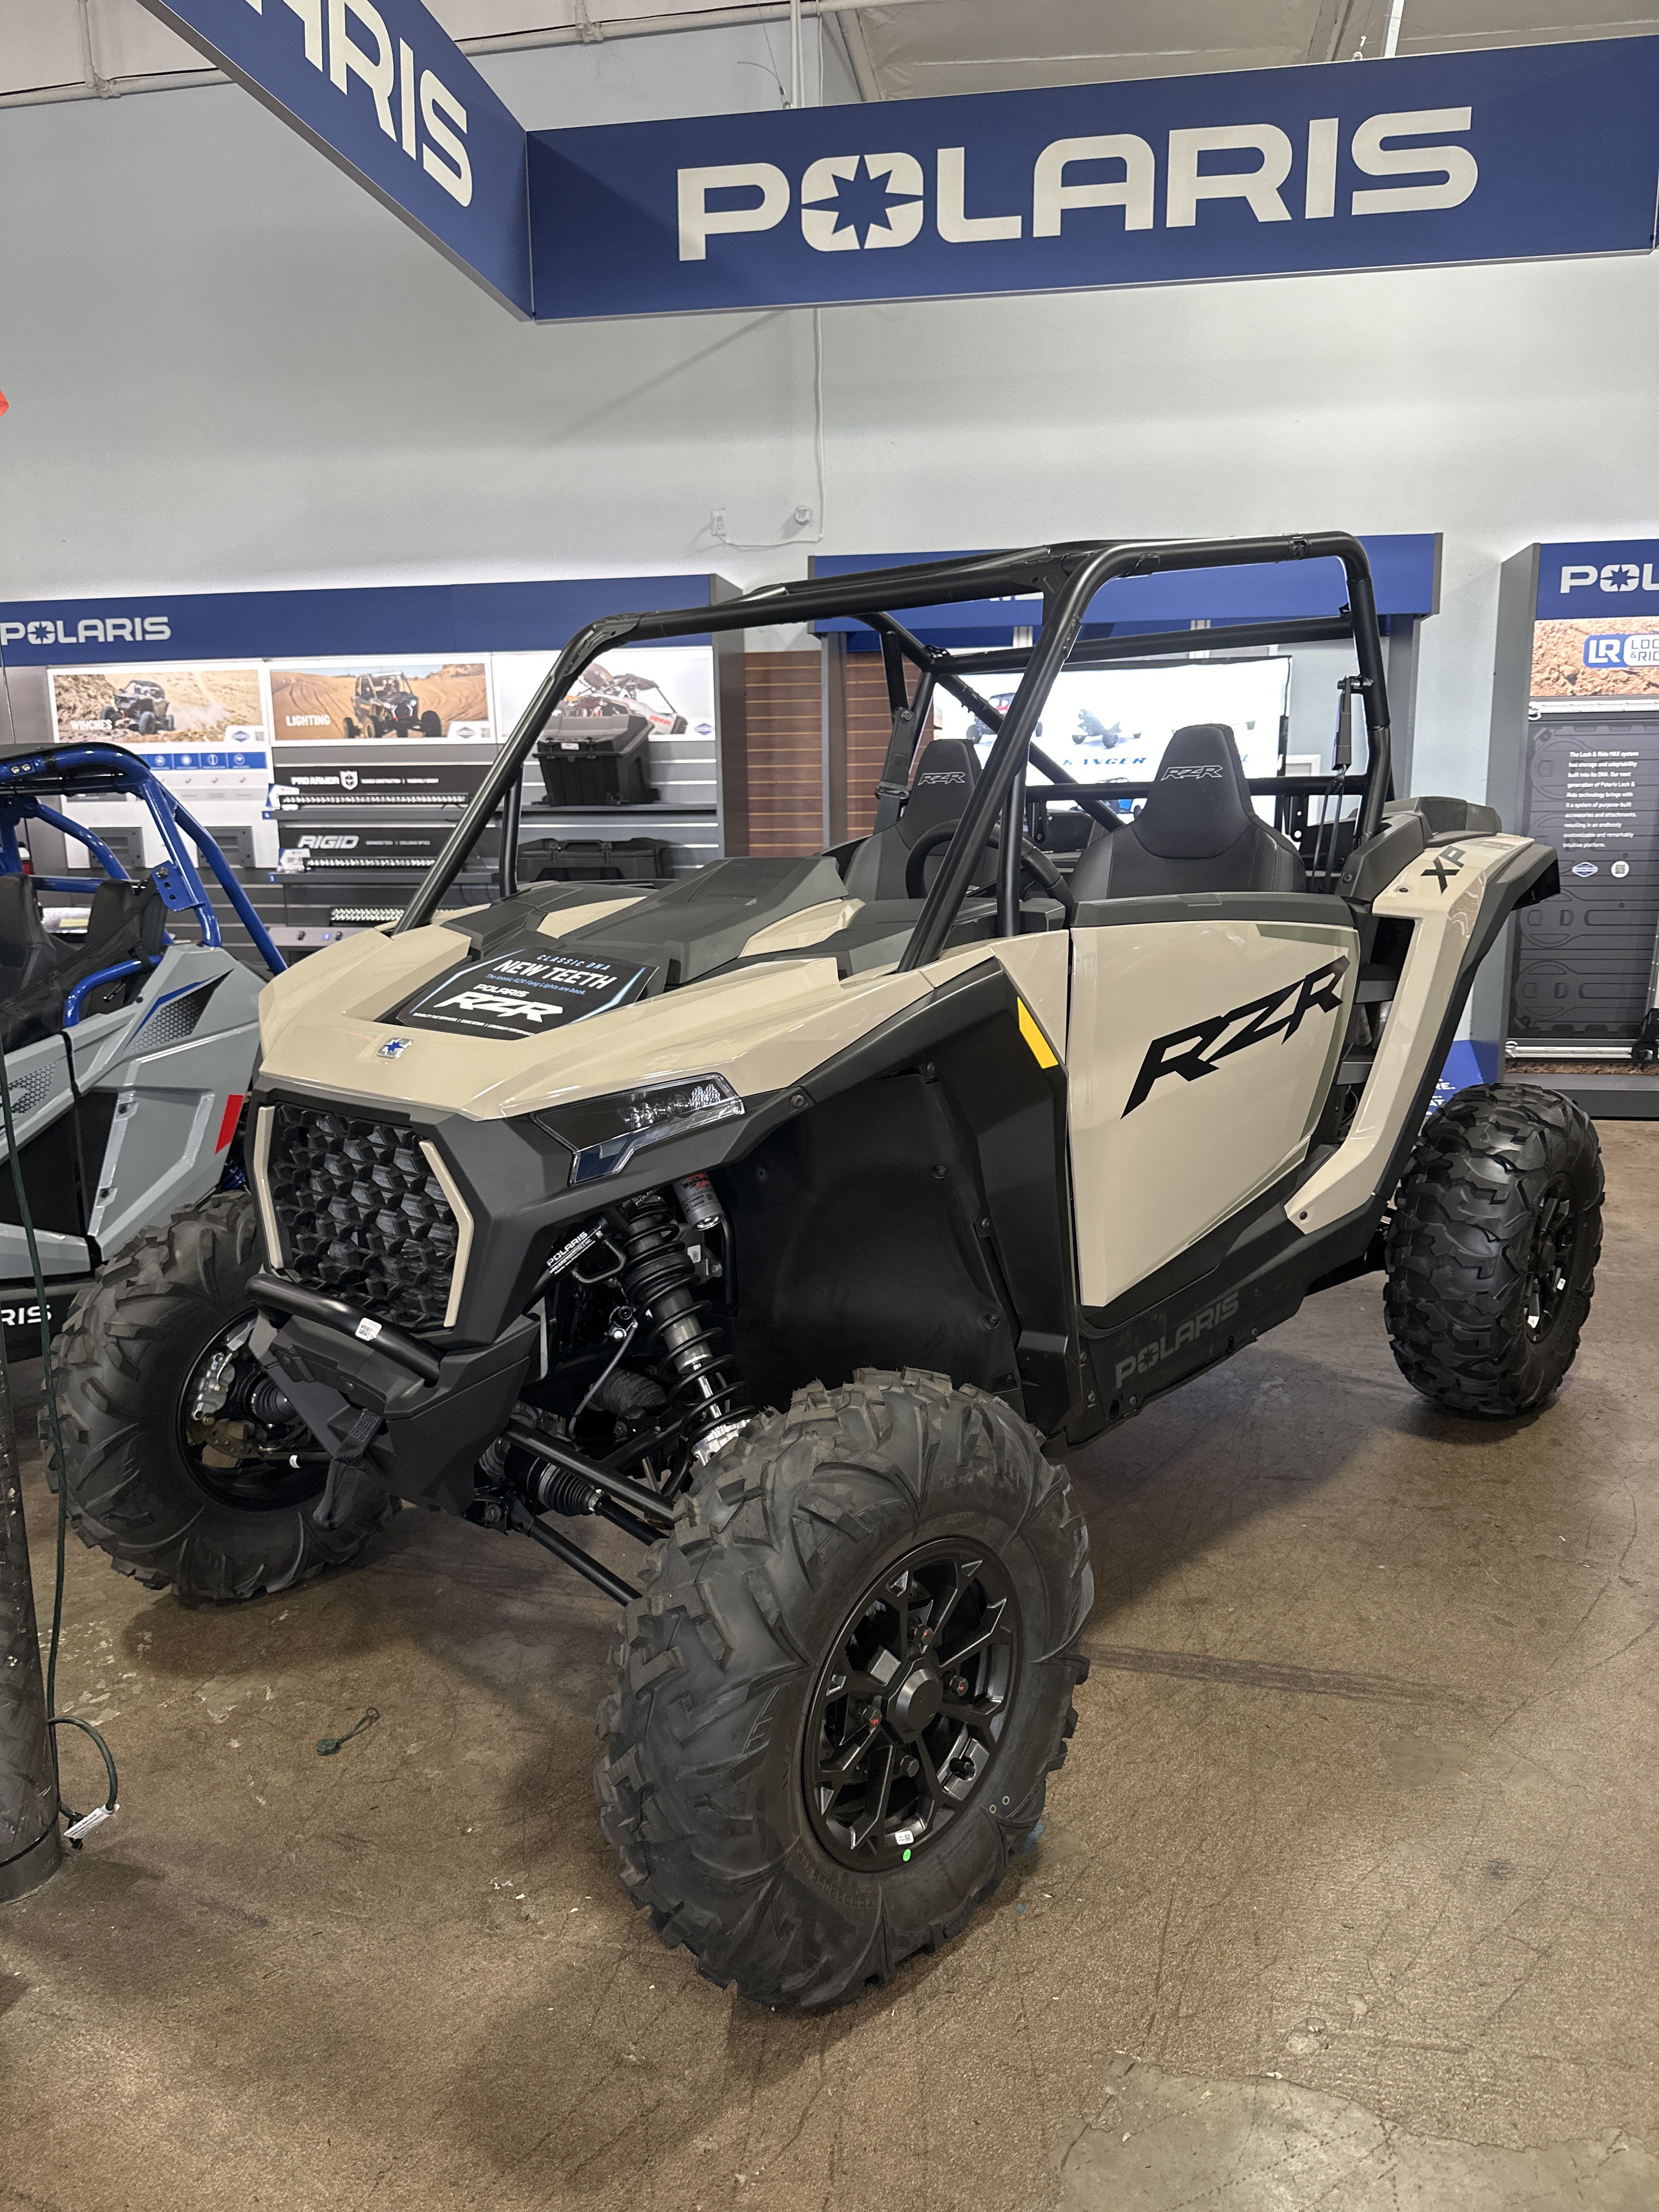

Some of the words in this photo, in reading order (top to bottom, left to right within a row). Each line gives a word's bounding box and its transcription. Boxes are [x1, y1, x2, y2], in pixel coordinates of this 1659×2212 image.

[678, 107, 1479, 261] POLARIS
[1, 616, 171, 646] POLARIS
[71, 720, 112, 730] WINCHES
[286, 714, 330, 726] LIGHTING
[917, 772, 966, 786] RZR
[1160, 765, 1223, 781] RZR
[298, 835, 359, 849] RIGID
[1421, 845, 1466, 894] XP
[537, 955, 585, 967] CLASSIC
[586, 962, 611, 970] DNA
[493, 960, 550, 976] NEW
[542, 967, 617, 989] TEETH
[473, 984, 529, 997] POLARIS
[539, 981, 560, 991] Lights
[569, 987, 586, 995] back.
[433, 991, 563, 1023] RZR
[1120, 955, 1350, 1120] RZR
[546, 1231, 588, 1266] POLARIS
[1115, 1291, 1239, 1389] POLARIS
